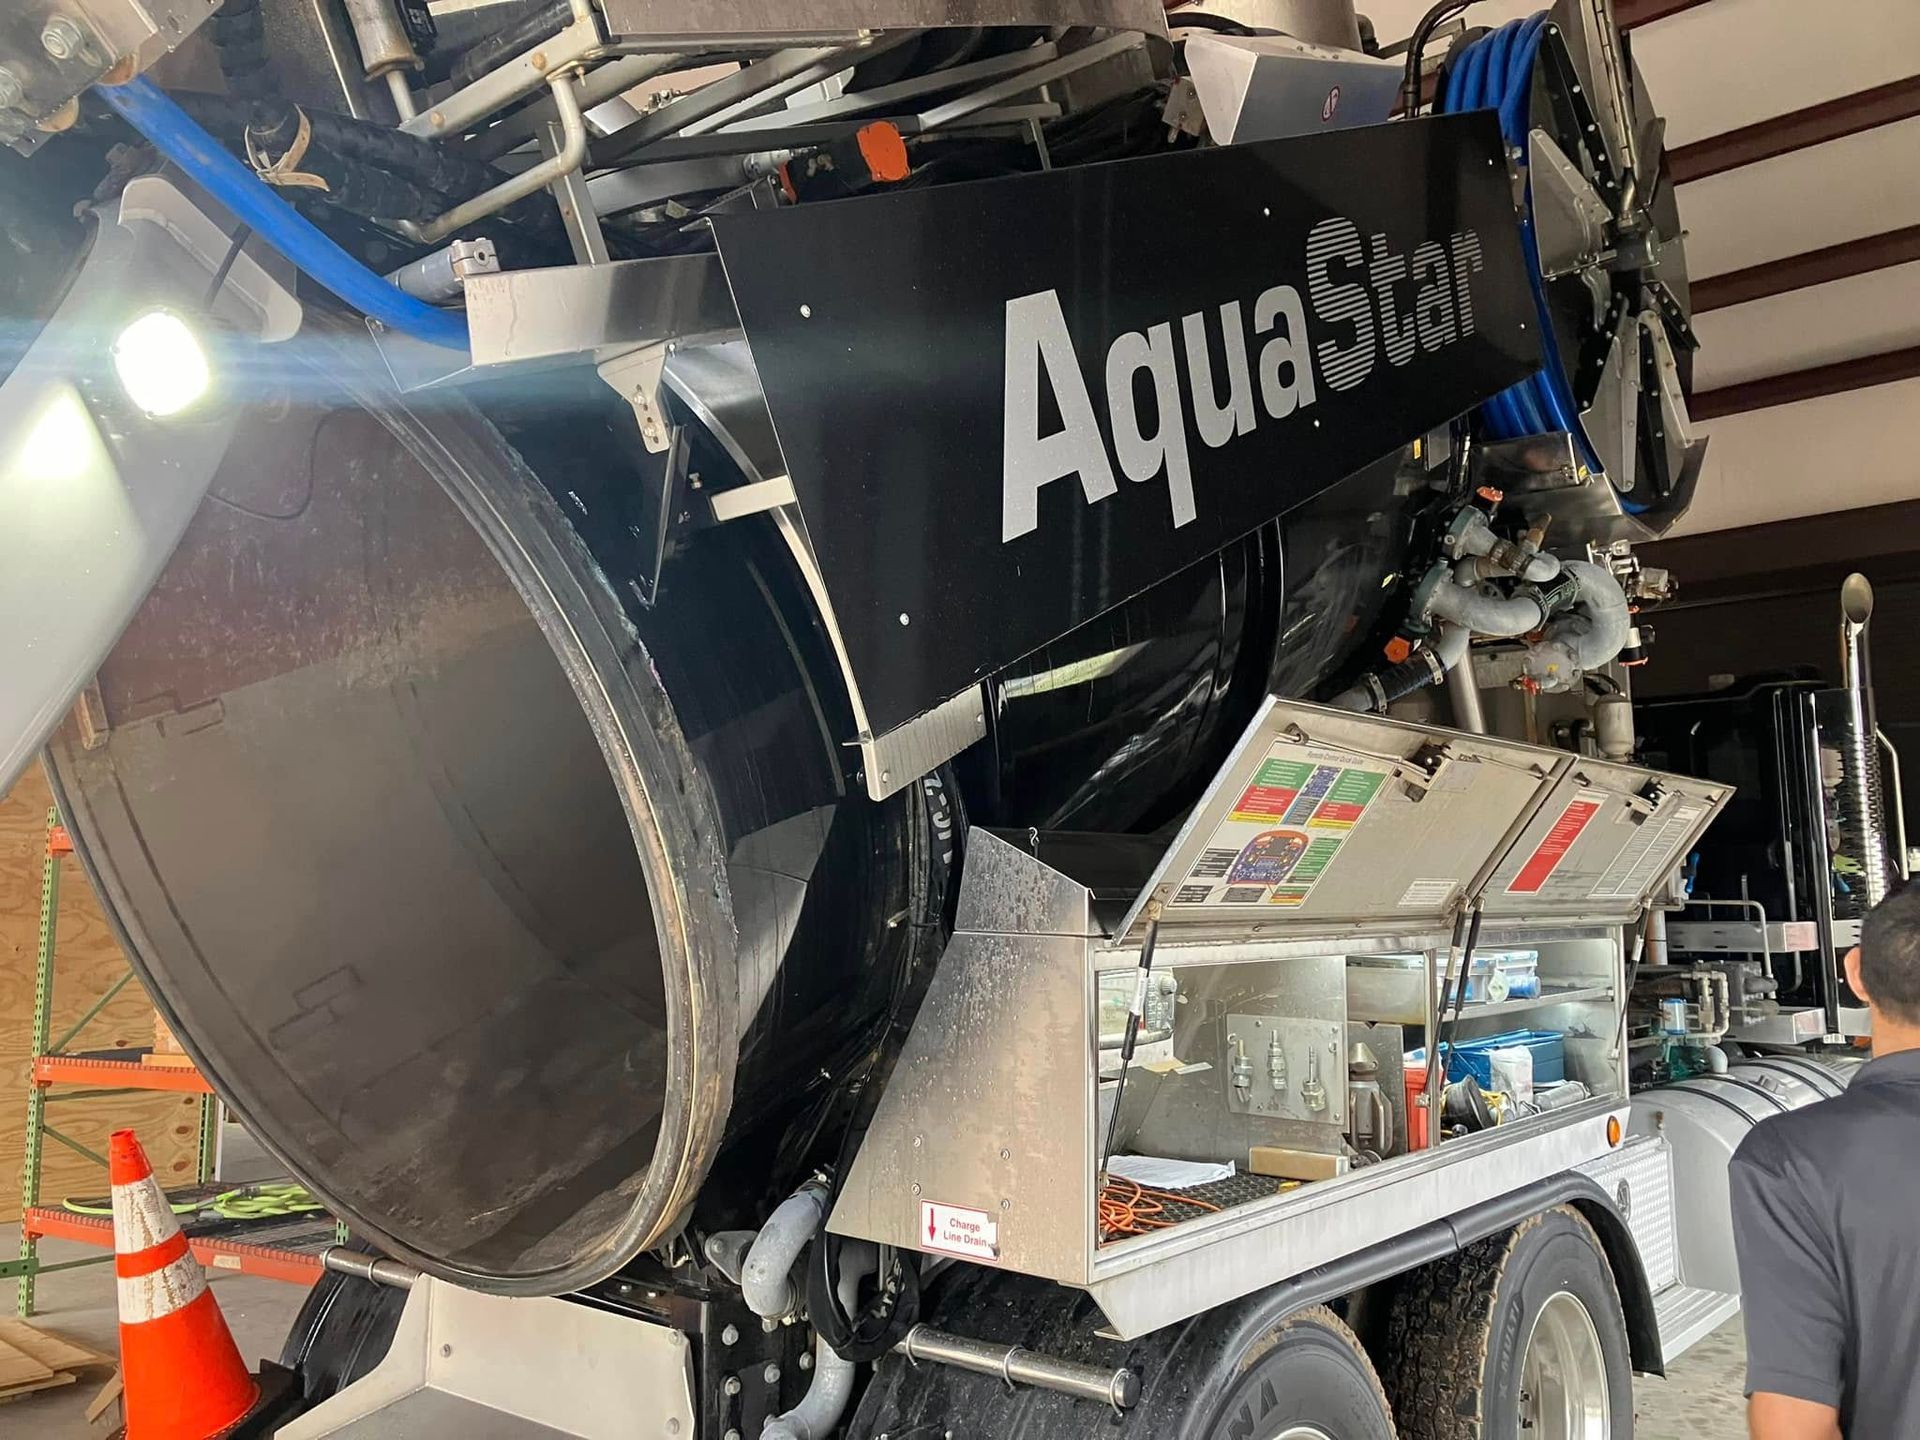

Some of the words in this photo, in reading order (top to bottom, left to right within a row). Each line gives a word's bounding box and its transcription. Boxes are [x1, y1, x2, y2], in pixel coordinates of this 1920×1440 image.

[1002, 216, 1484, 544] AquaStar
[943, 1230, 962, 1243] Line
[964, 1234, 987, 1247] Drain
[949, 1217, 981, 1233] Charge
[1501, 1300, 1519, 1373] MULTI
